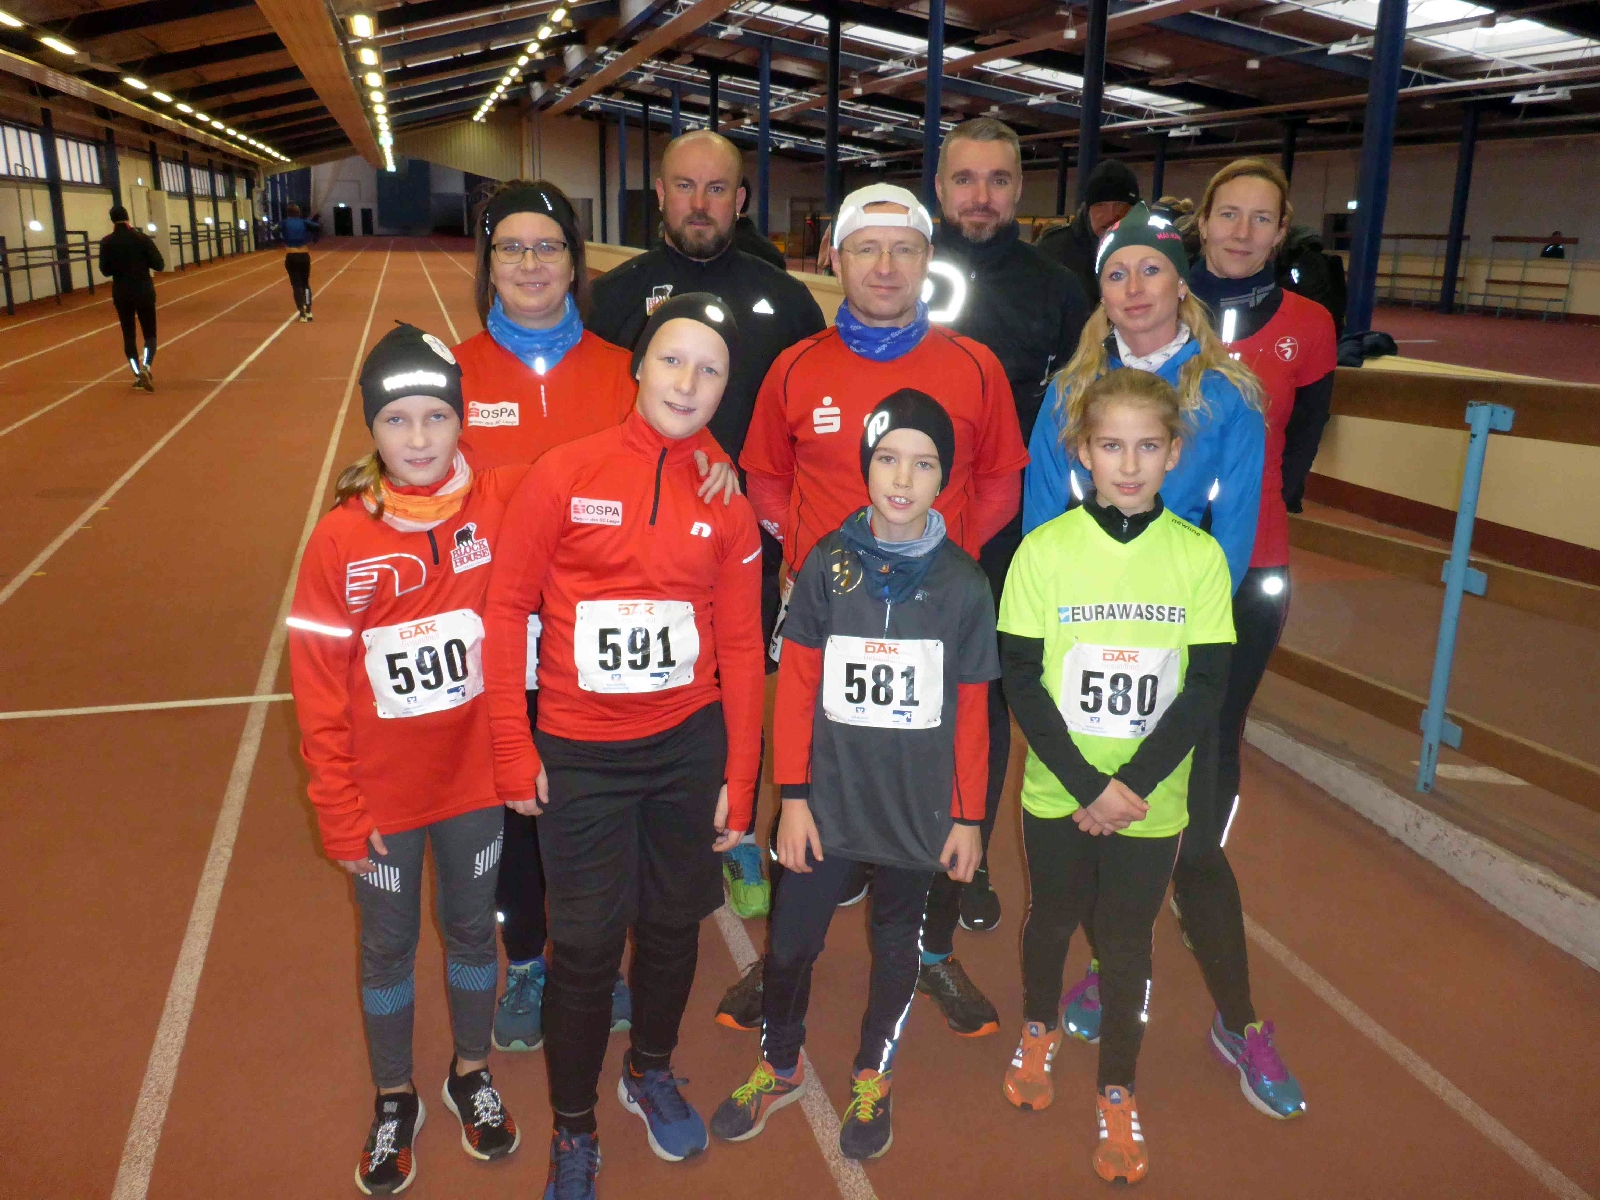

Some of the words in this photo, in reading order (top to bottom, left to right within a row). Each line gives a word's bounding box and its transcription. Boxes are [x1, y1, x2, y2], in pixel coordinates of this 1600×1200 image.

[480, 407, 517, 419] OSPA
[586, 505, 620, 517] OSPA
[452, 539, 487, 560] BLOCK
[453, 548, 490, 568] HOUSE
[1071, 603, 1186, 624] EURAWASSER
[398, 619, 438, 640] DAK
[598, 626, 677, 671] 591
[865, 641, 900, 655] DAK
[1102, 648, 1140, 663] DAK
[385, 638, 469, 695] 590
[844, 662, 920, 707] 581
[1080, 669, 1159, 717] 580
